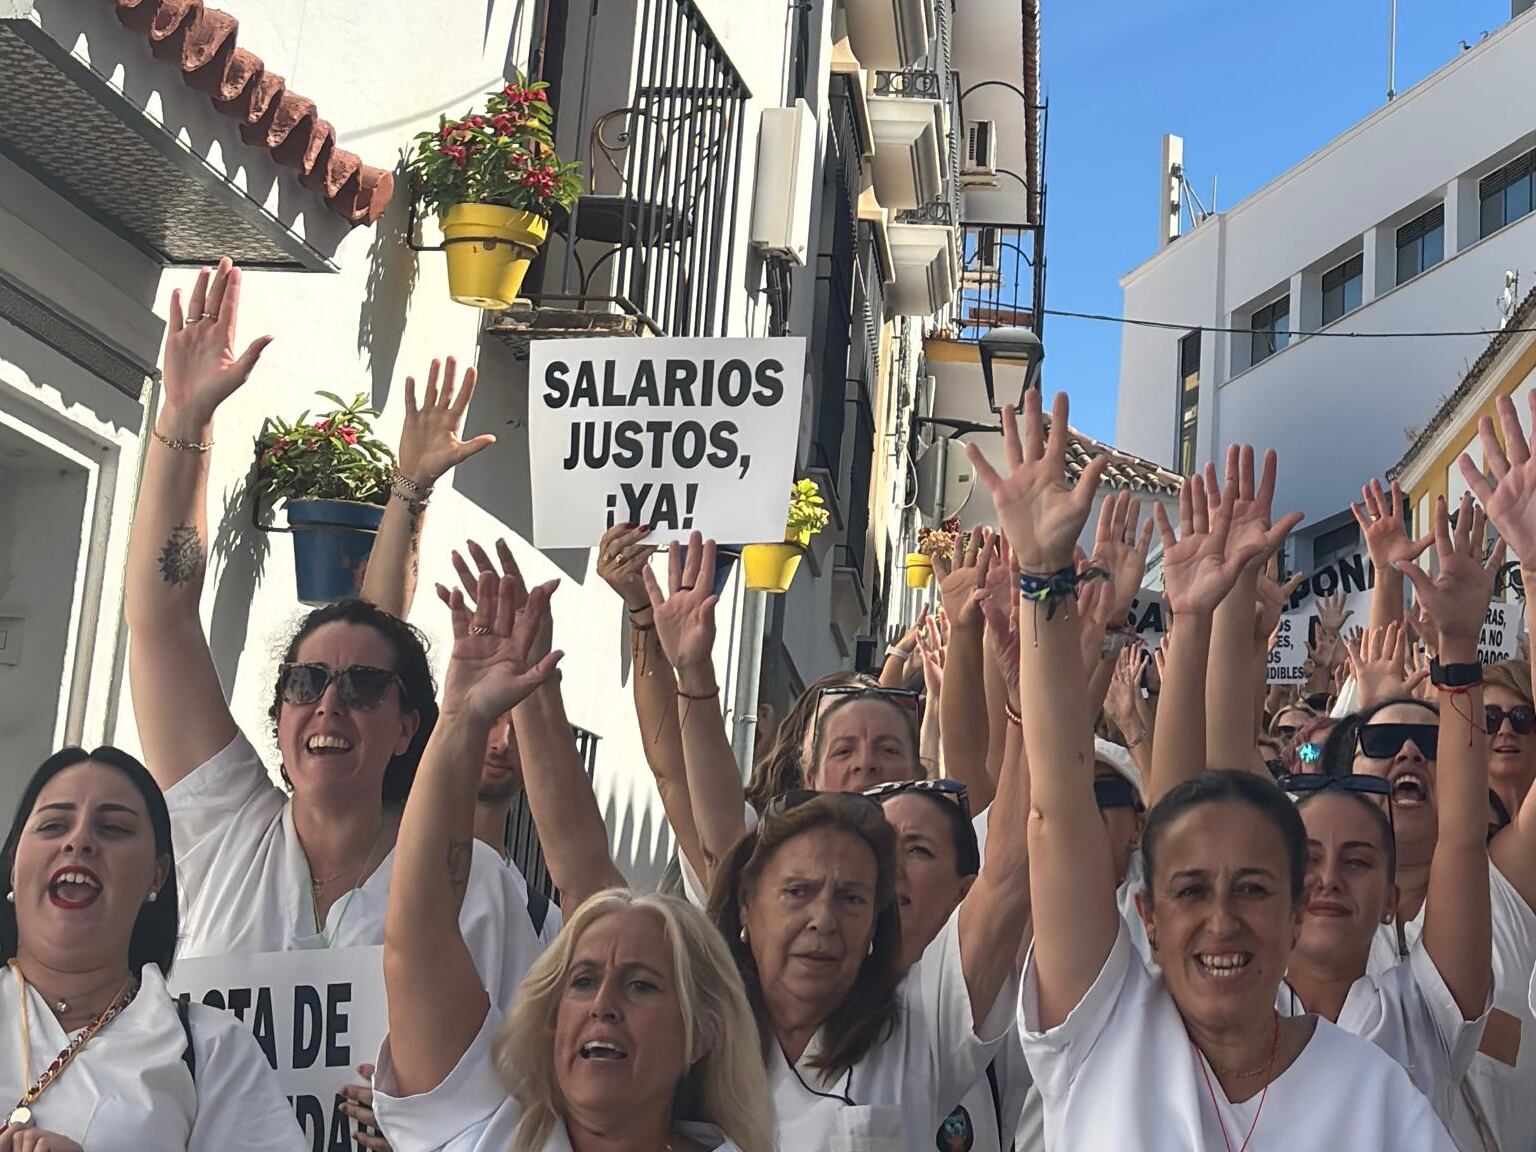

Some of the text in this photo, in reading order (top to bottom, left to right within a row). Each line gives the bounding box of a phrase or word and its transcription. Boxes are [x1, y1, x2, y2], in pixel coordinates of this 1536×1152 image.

[543, 358, 784, 409] SALARIOS
[563, 420, 751, 480] JUSTOS,
[292, 982, 352, 1069] DE
